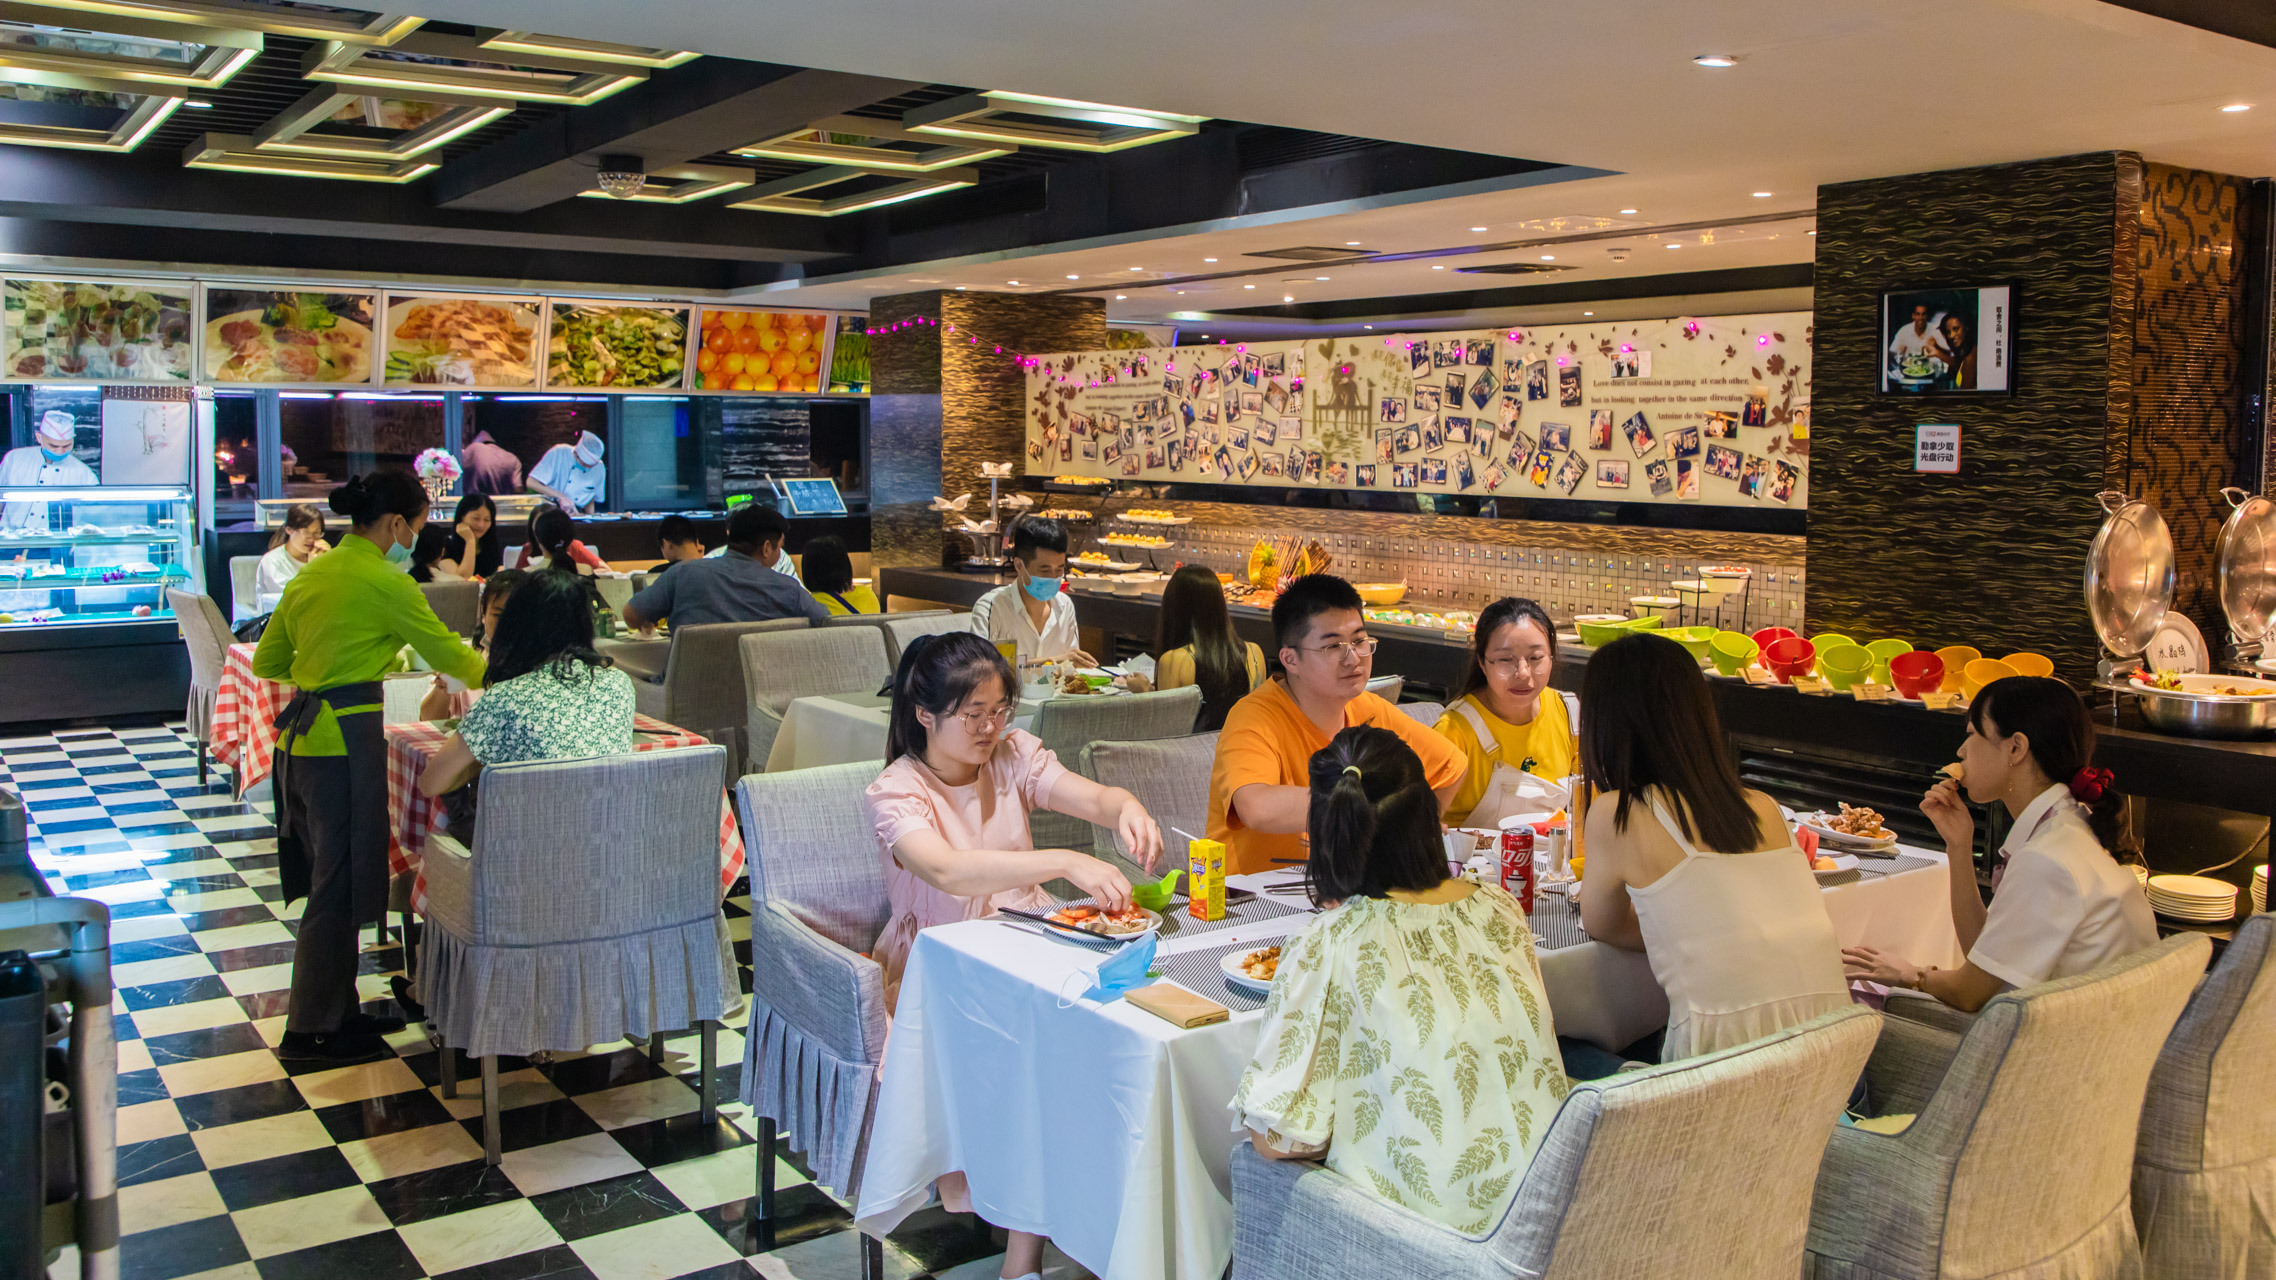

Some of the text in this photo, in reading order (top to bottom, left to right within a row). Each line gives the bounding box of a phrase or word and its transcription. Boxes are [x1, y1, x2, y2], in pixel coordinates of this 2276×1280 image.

[1611, 379, 1625, 387] does
[1673, 379, 1696, 387] gazing
[1710, 377, 1726, 385] each
[1611, 396, 1635, 404] looking
[1638, 395, 1667, 404] together
[1710, 393, 1743, 402] direction
[1656, 412, 1682, 420] Antoine
[1921, 441, 1954, 451] 勤拿少取
[1920, 452, 1954, 462] 光盘行动
